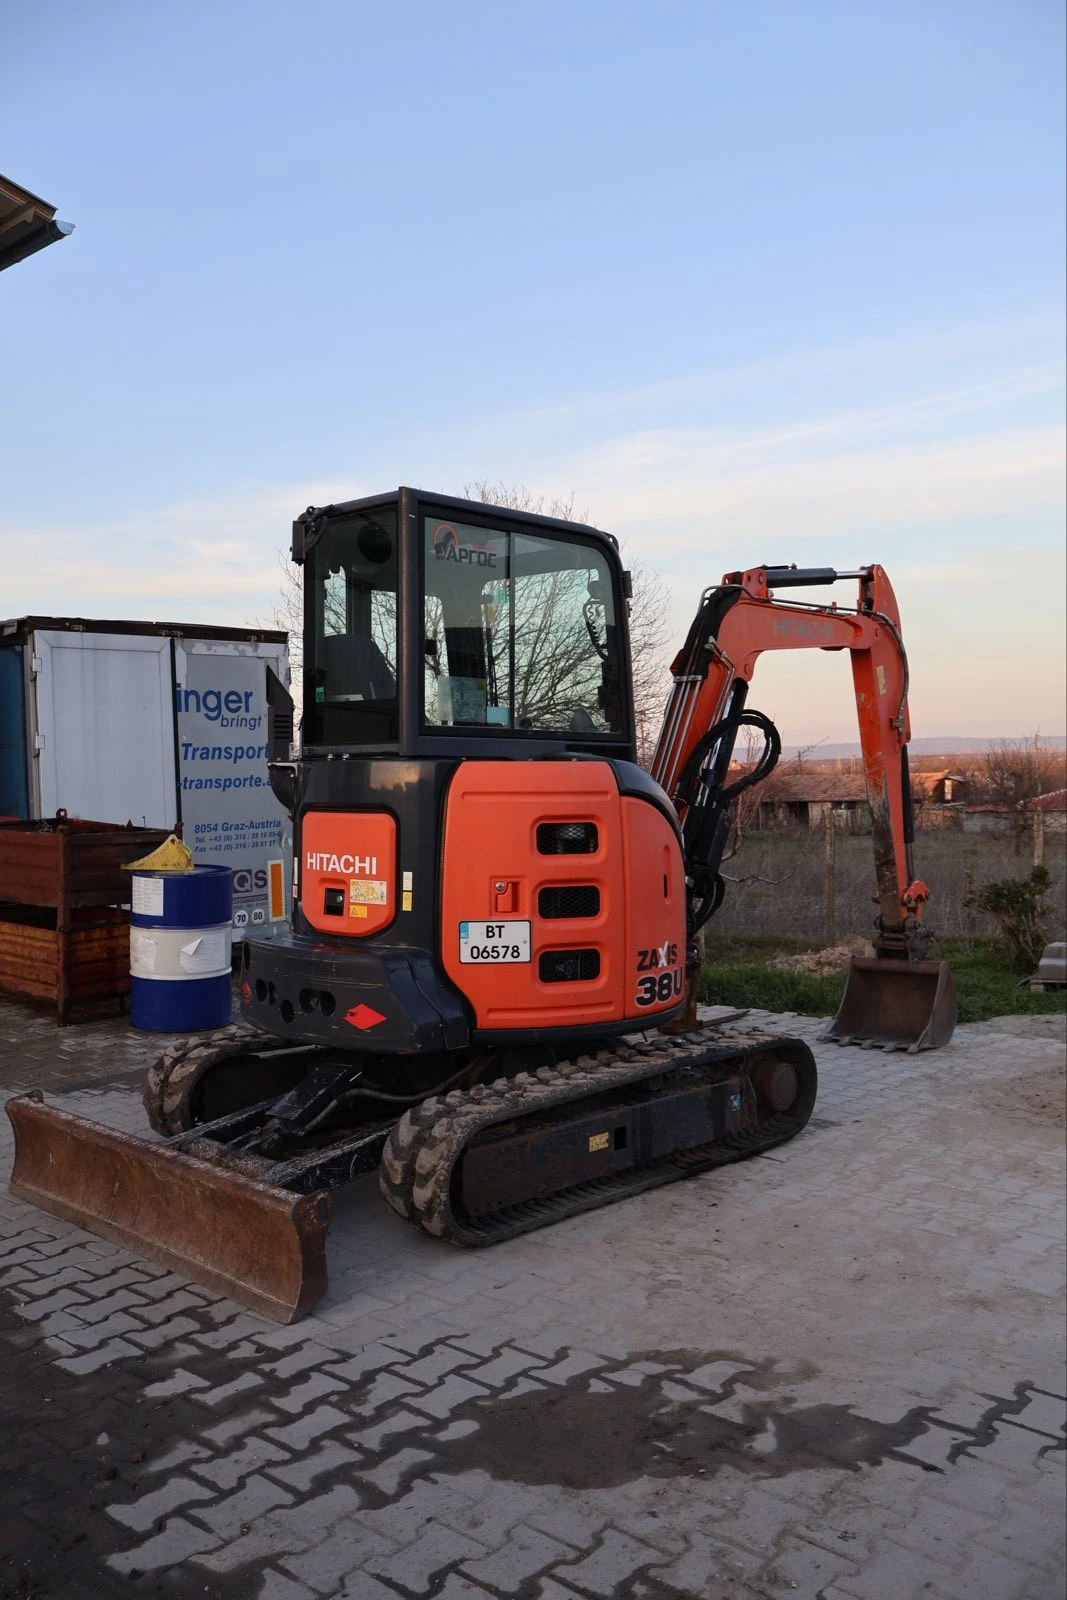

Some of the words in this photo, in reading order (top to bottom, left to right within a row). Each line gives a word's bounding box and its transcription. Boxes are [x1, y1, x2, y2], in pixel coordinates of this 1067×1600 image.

[773, 617, 833, 640] HITACHI
[176, 683, 253, 721] inger
[194, 823, 218, 834] 8054
[221, 818, 281, 832] Graz-Austria
[306, 851, 377, 875] HITACHI
[236, 914, 247, 924] 70
[253, 911, 263, 921] 80
[486, 925, 505, 938] BT
[470, 945, 520, 959] 06578
[637, 941, 677, 971] ZAXIS
[635, 967, 684, 1007] 38U
